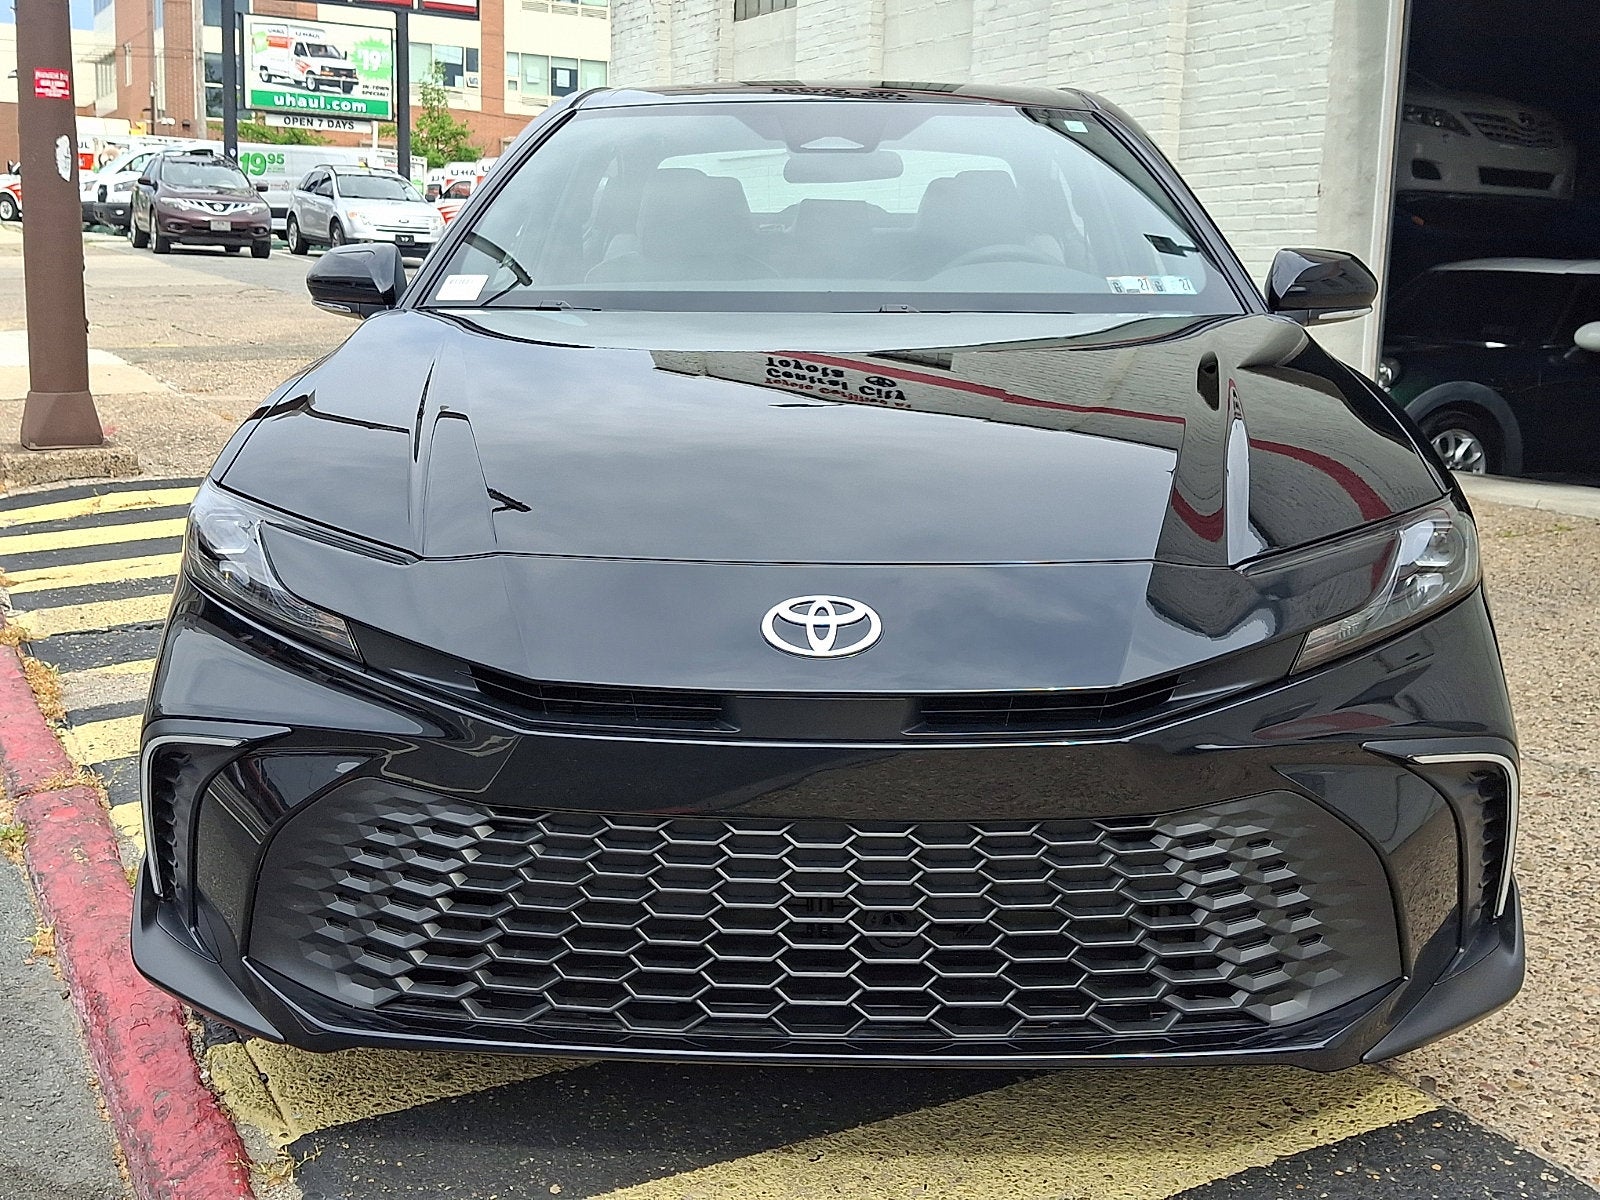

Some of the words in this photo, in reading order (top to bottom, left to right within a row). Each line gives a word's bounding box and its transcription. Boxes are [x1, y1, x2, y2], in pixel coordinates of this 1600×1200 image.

[273, 92, 367, 113] uhaul.com
[283, 116, 314, 127] OPEN
[327, 120, 355, 130] DAYS
